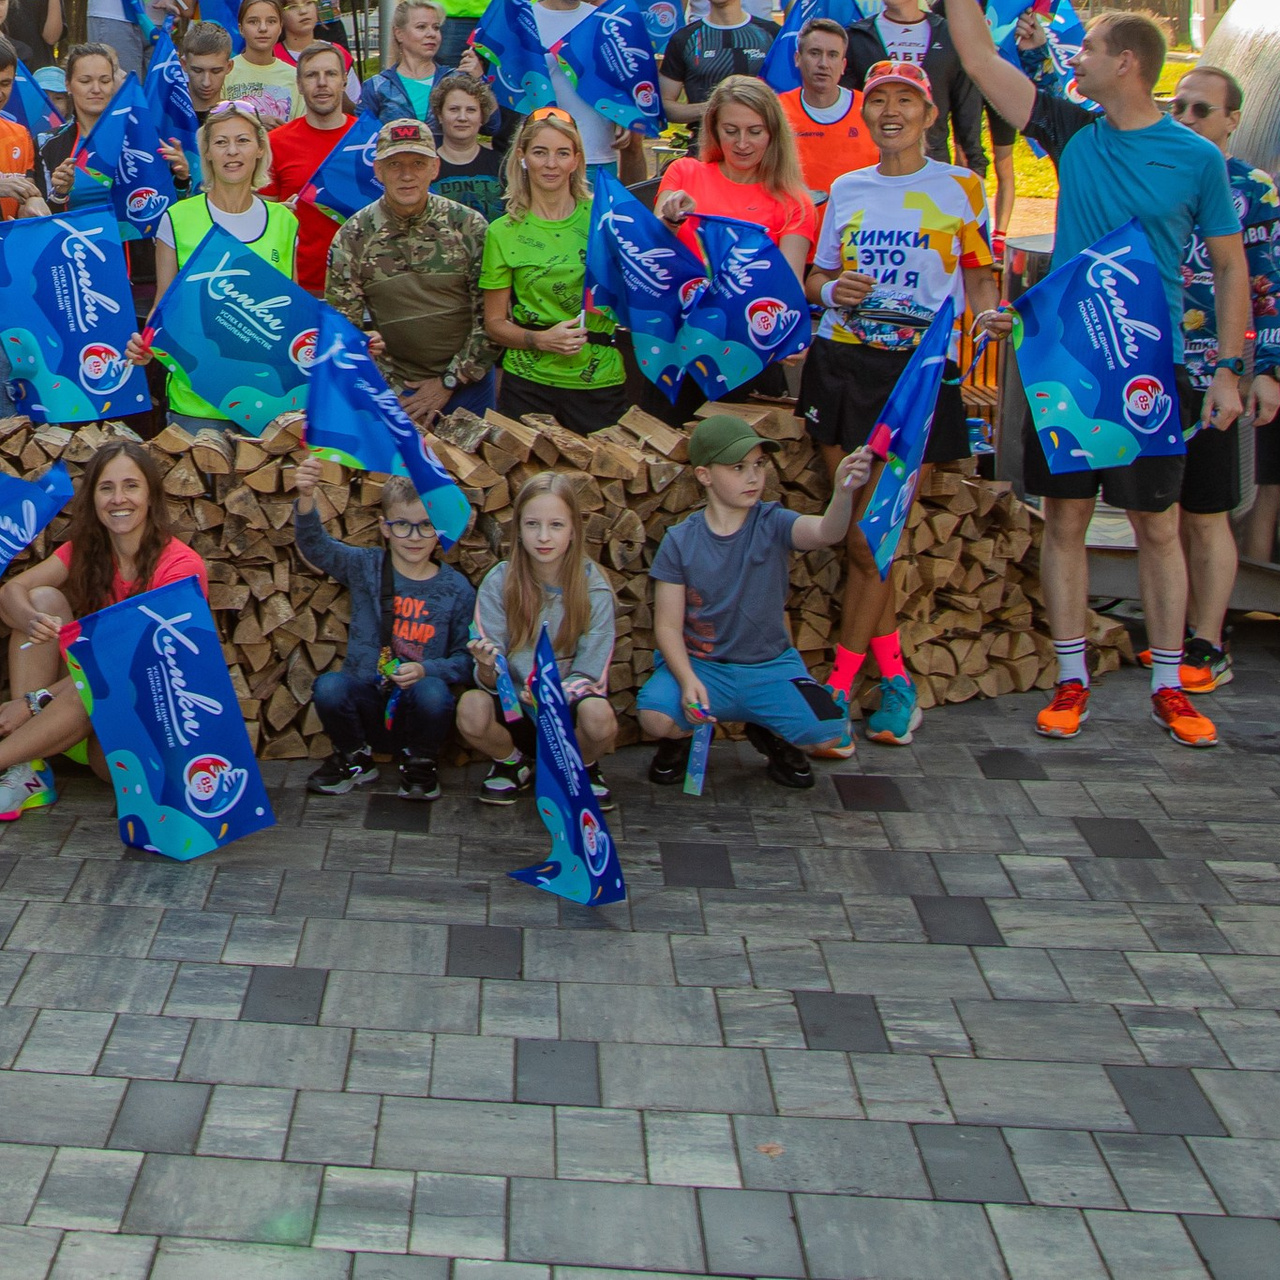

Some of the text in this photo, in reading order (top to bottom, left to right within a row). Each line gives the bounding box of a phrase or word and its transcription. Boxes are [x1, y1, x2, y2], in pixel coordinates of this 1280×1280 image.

[848, 230, 930, 250] ХИМКИ
[860, 249, 906, 266] ЭТО
[50, 266, 64, 311] ПОКОЛЕНИЙ
[58, 265, 68, 292] УСПЕХ
[63, 296, 76, 332] ЕДИНСТВЕ
[185, 251, 292, 341] Химки
[628, 273, 662, 300] ЕДИНСТВЕ
[905, 271, 920, 289] Я
[760, 316, 771, 331] 85
[1077, 300, 1100, 350] ПОКОЛЕНИЙ
[1080, 245, 1162, 369] Химки
[215, 316, 250, 343] ПОКОЛЕНИЙ
[220, 310, 238, 325] УСПЕХ
[242, 325, 273, 350] ЕДИНСТВЕ
[1086, 298, 1099, 325] УСПЕХ
[1098, 331, 1115, 370] ЕДИНСТВЕ
[92, 361, 102, 375] 85
[1139, 395, 1149, 411] 85
[137, 605, 223, 746] Химки
[146, 667, 162, 722] ПОКОЛЕНИЙ
[152, 665, 162, 695] УСПЕХ
[159, 703, 176, 748] ЕДИНСТВЕ
[200, 776, 213, 793] 85
